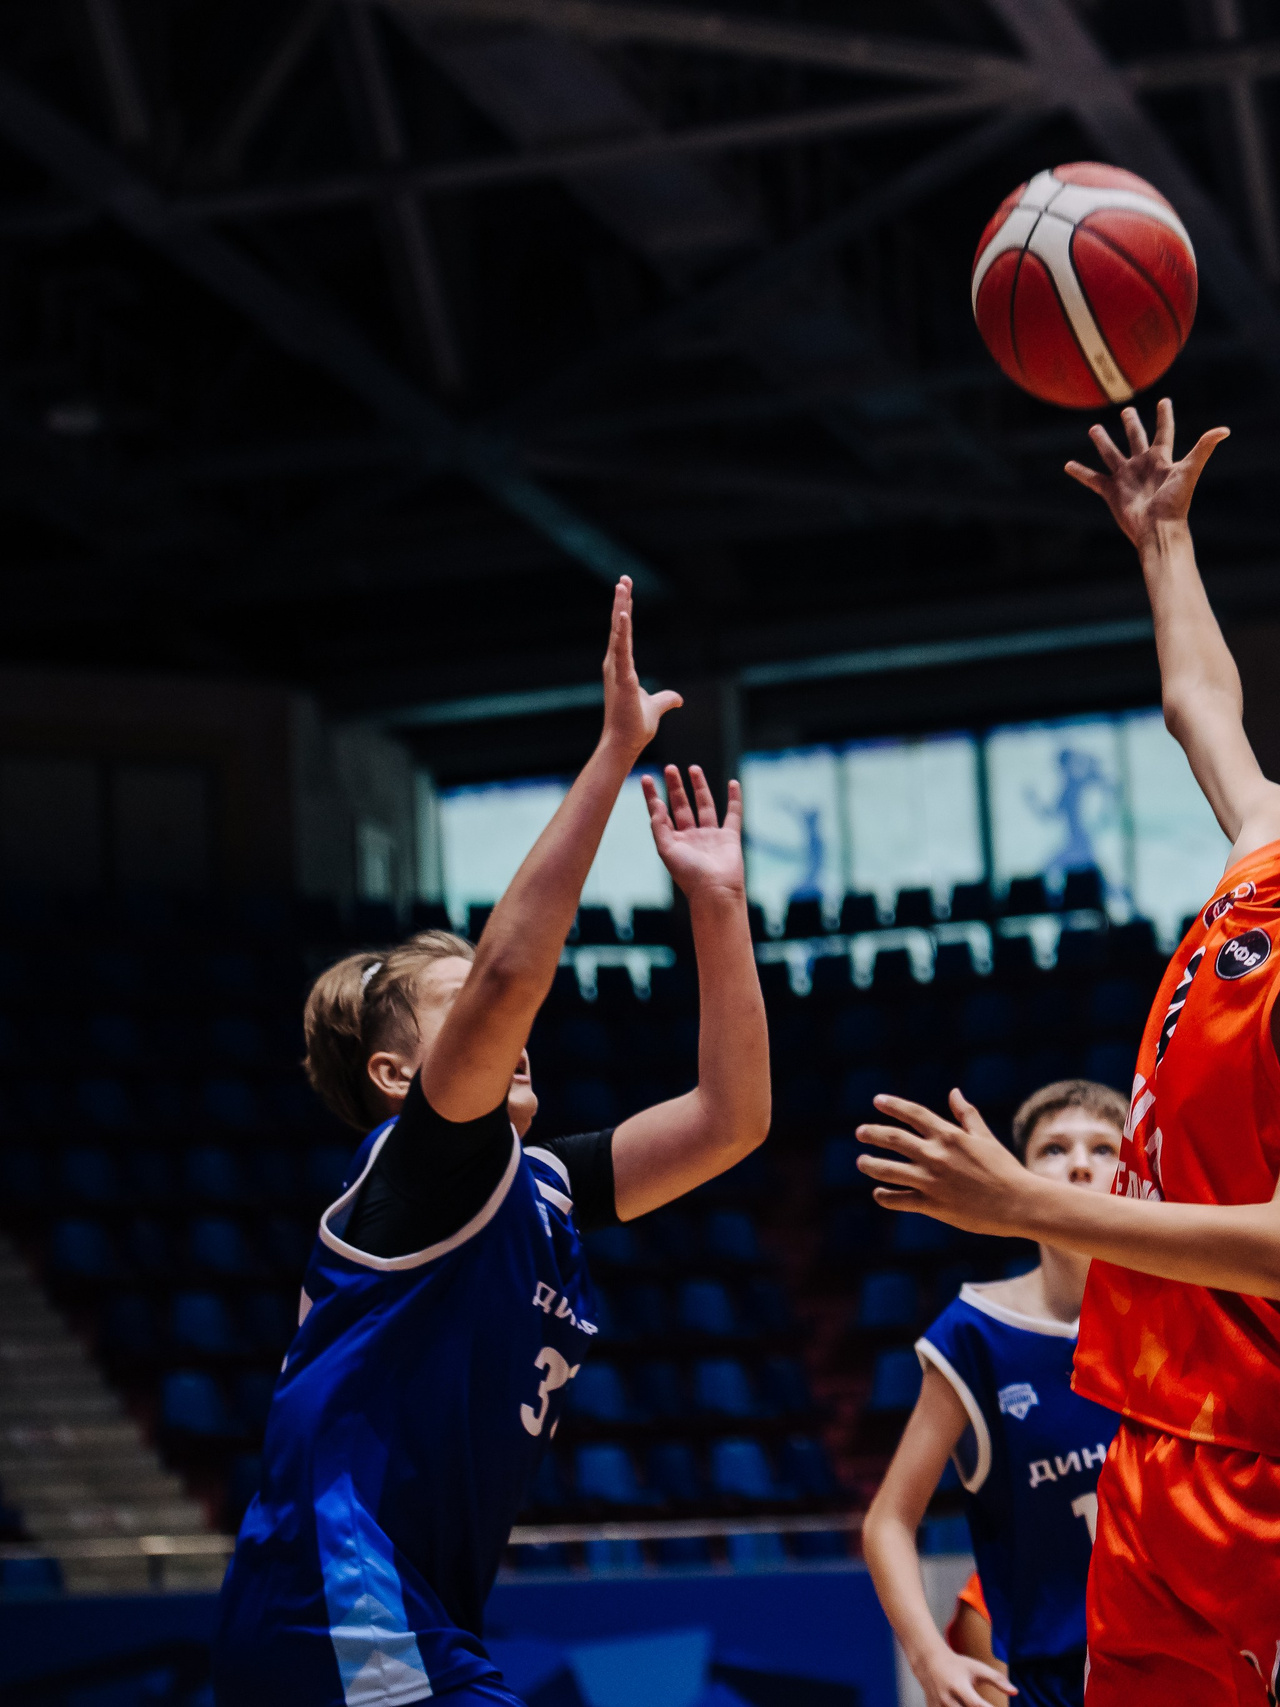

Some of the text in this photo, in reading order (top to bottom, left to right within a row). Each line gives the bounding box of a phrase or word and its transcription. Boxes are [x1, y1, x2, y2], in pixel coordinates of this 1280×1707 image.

[1224, 939, 1262, 968] РФБ
[520, 1346, 581, 1440] 3
[1028, 1442, 1108, 1489] ДИН
